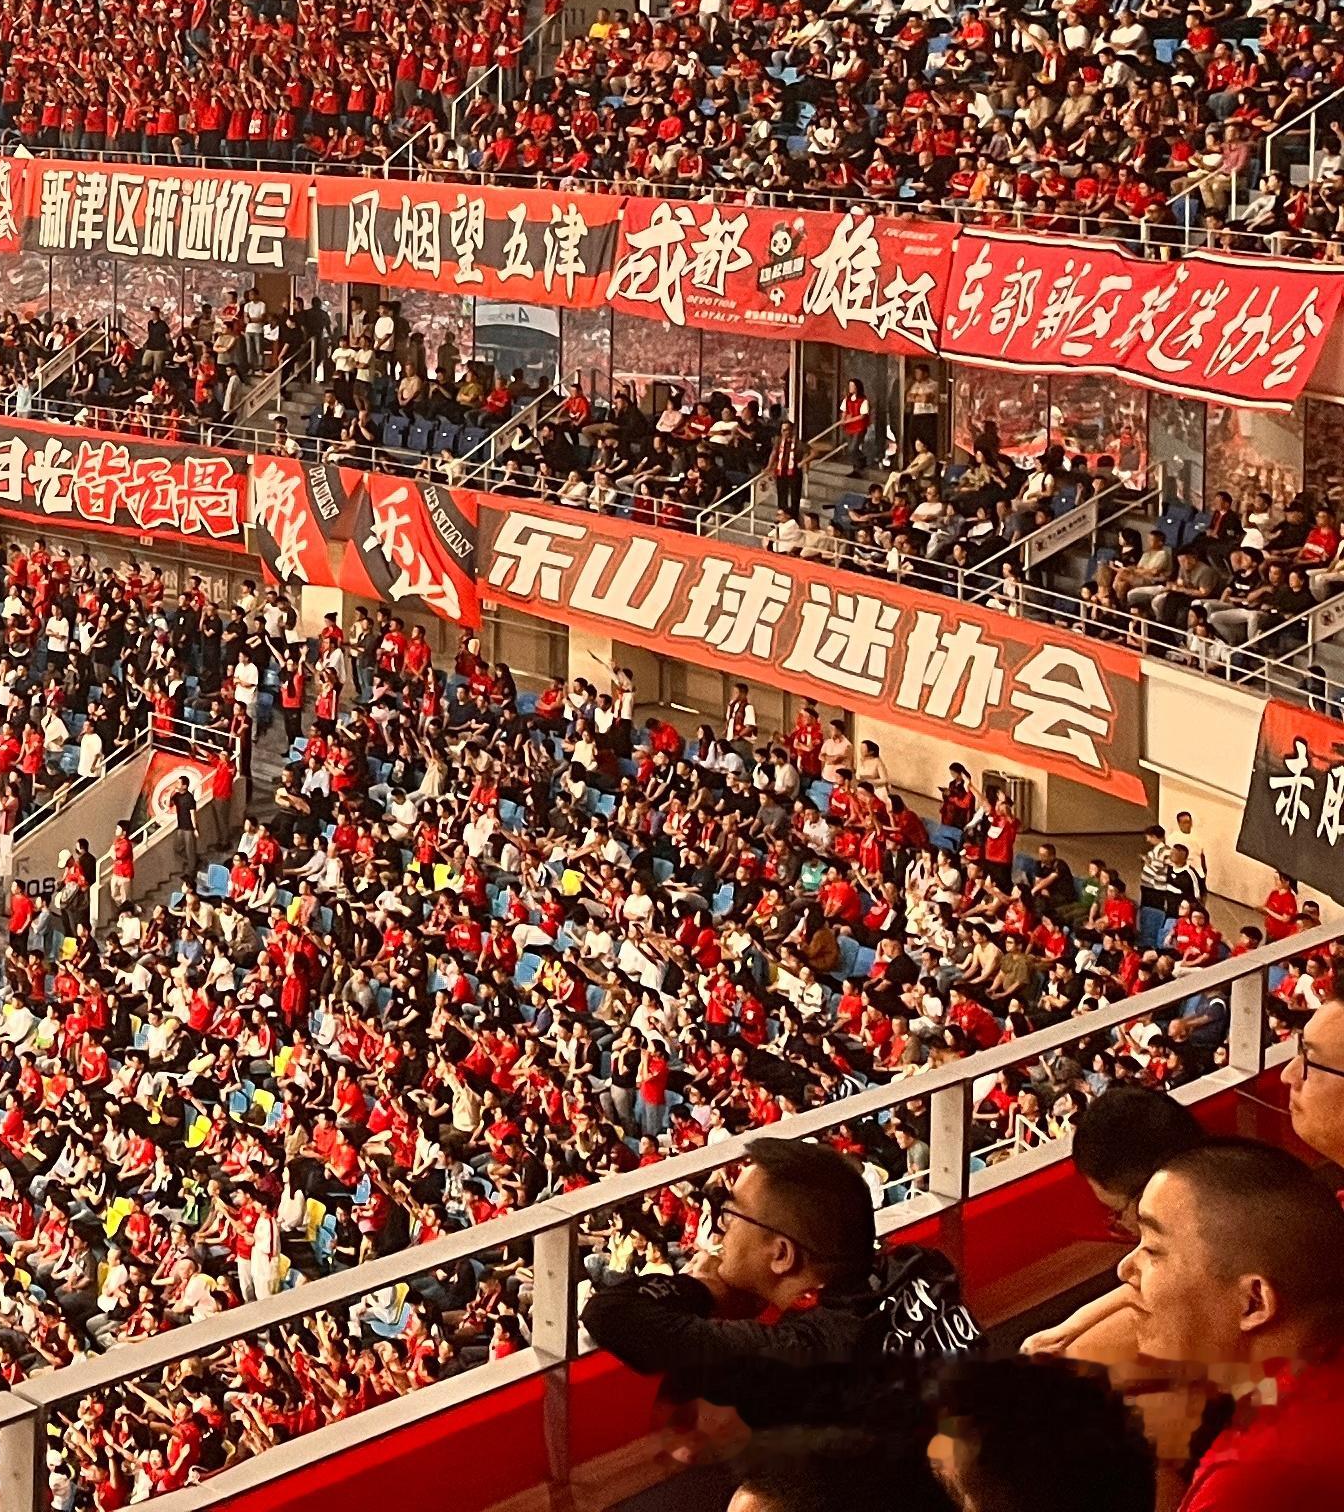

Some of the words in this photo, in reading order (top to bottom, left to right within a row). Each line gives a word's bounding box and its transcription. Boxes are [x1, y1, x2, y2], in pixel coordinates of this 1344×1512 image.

[39, 169, 292, 268] 新津区球迷协会
[345, 189, 589, 300] 风烟望五津
[605, 202, 753, 326] 成都
[802, 212, 939, 355] 雄起
[946, 242, 1325, 389] 东部新区球迷协会
[485, 511, 1114, 769] 乐山球迷协会
